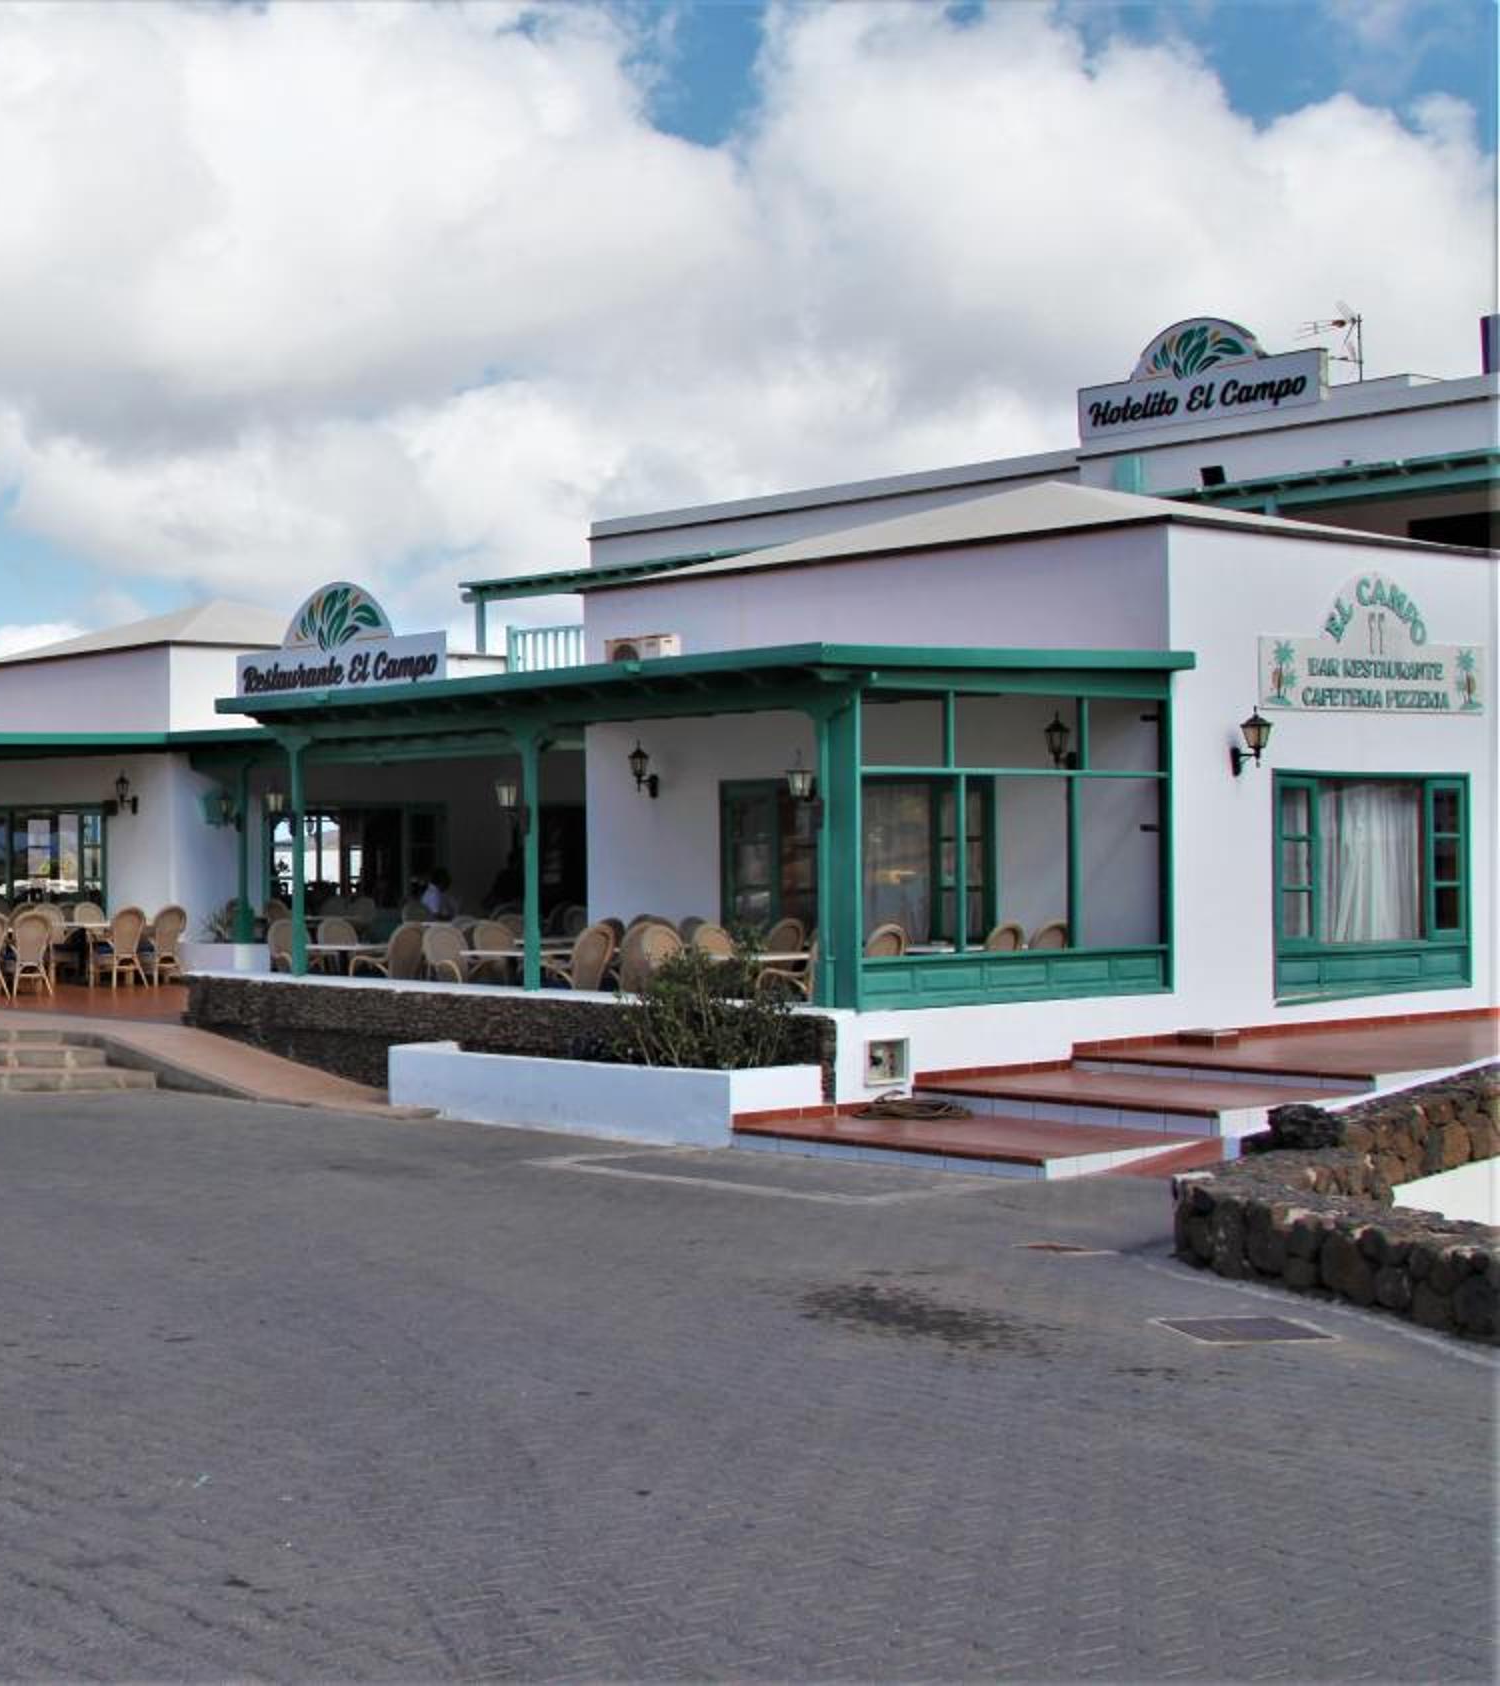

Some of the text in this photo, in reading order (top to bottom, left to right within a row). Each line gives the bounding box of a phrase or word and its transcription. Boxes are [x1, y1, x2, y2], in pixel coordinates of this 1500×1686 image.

[1088, 375, 1308, 427] Hotelito El Campo
[1355, 576, 1428, 647] CAMPO
[243, 650, 438, 694] Restaurante El Campo
[1307, 656, 1444, 682] BAR RESTAURANTE
